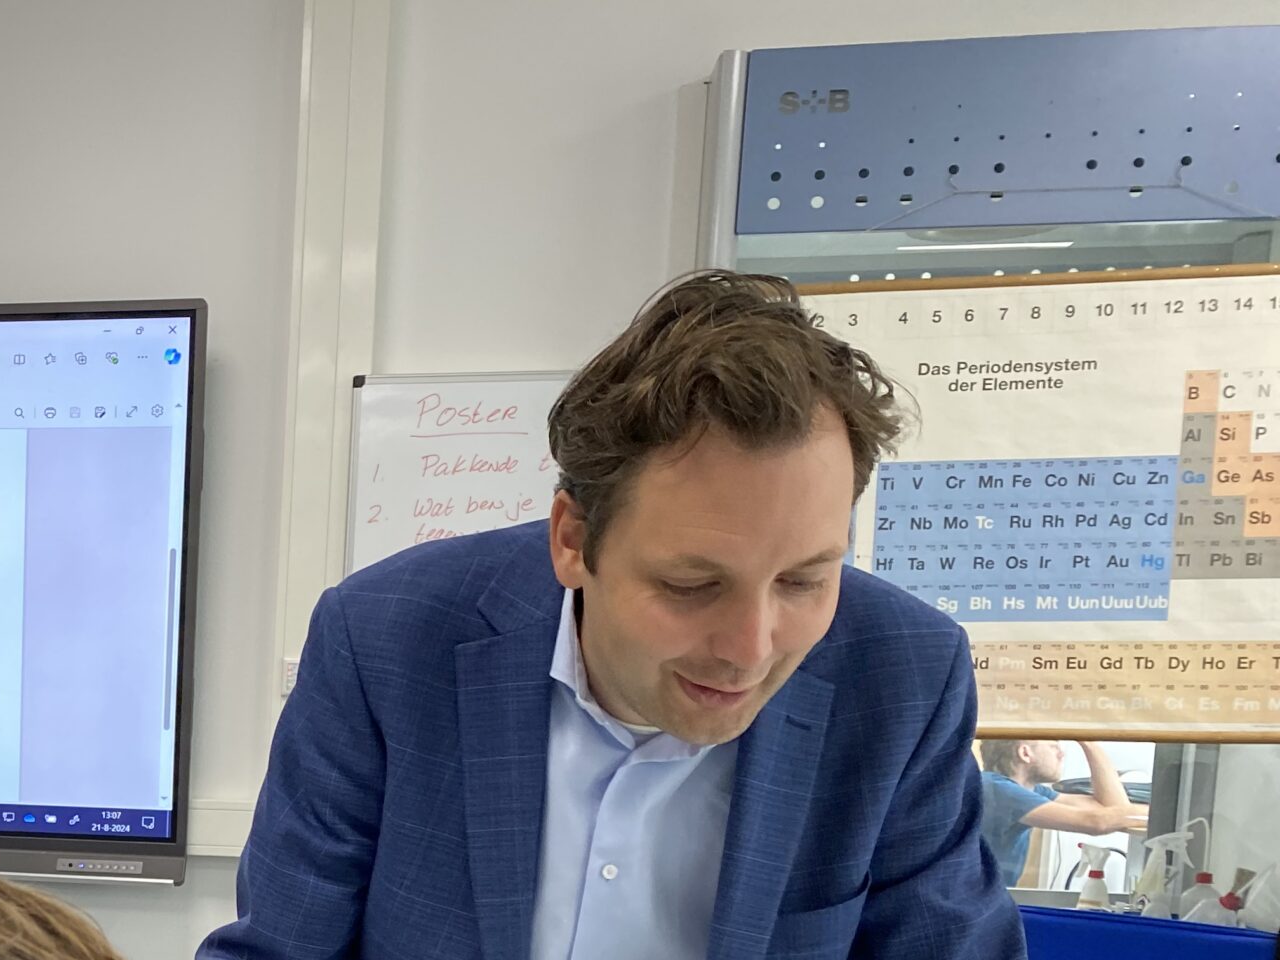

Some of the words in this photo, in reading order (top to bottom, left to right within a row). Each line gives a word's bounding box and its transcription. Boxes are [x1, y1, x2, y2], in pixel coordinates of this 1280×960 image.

[779, 89, 849, 115] S+B
[848, 314, 858, 326] 3
[899, 312, 908, 324] 4
[932, 310, 942, 323] 5
[964, 309, 975, 322] 6
[999, 308, 1009, 321] 7
[1031, 306, 1041, 319] 8
[1065, 305, 1076, 318] 9
[1096, 304, 1114, 317] 10
[1131, 302, 1148, 315] 11
[1164, 300, 1184, 314] 12
[1198, 299, 1218, 312] 13
[1234, 297, 1254, 311] 14
[918, 363, 950, 376] Das
[956, 359, 1098, 376] Periodensystem
[948, 379, 977, 392] der
[982, 377, 1064, 391] Elemente
[1188, 387, 1200, 400] B
[1223, 385, 1236, 399] C
[1184, 428, 1201, 442] Al
[1219, 427, 1236, 441] Si
[1255, 426, 1267, 439] P
[881, 477, 894, 490] Ti
[912, 477, 923, 489] V
[946, 476, 966, 489] Cr
[979, 475, 1004, 488] Mn
[1013, 475, 1032, 488] Fe
[1045, 474, 1067, 487] Co
[1078, 473, 1095, 486] Ni
[1113, 472, 1136, 485] Cu
[1147, 472, 1168, 485] Zn
[1182, 471, 1205, 484] Ga
[1217, 470, 1241, 483] Ge
[1252, 469, 1275, 482] As
[878, 518, 896, 531] Zr
[910, 517, 932, 530] Nb
[944, 516, 968, 529] Mo
[976, 516, 994, 529] Tc
[1010, 515, 1032, 528] Ru
[1042, 515, 1064, 528] Rh
[1076, 514, 1097, 527] Pd
[1109, 514, 1132, 529] Ag
[1144, 513, 1168, 526] Cd
[1179, 512, 1194, 525] In
[1213, 512, 1235, 525] Sn
[1249, 511, 1272, 524] Sb
[876, 558, 894, 571] Hf
[908, 558, 925, 570] Ta
[940, 557, 956, 570] W
[973, 557, 995, 569] Re
[1006, 556, 1028, 569] Os
[1039, 556, 1051, 568] Ir
[1072, 555, 1090, 568] Pt
[1106, 555, 1129, 568] Au
[1141, 554, 1165, 570] Hg
[1210, 553, 1232, 567] Pb
[1245, 553, 1262, 566] Bi
[936, 597, 958, 613] Sg
[970, 597, 991, 610] Bh
[1003, 597, 1025, 610] Hs
[1036, 596, 1058, 609] Mt
[1068, 596, 1099, 609] Uun
[1101, 596, 1133, 609] Uuu
[1135, 595, 1168, 609] Uub
[1032, 657, 1058, 669] Sm
[1066, 657, 1087, 669] Eu
[1100, 657, 1123, 669] Gd
[1134, 657, 1155, 669] Tb
[1168, 657, 1190, 672] Dy
[1202, 657, 1225, 669] Ho
[1237, 656, 1256, 669] Er
[102, 811, 121, 819] 13:07
[91, 823, 130, 833] 21-8-2024
